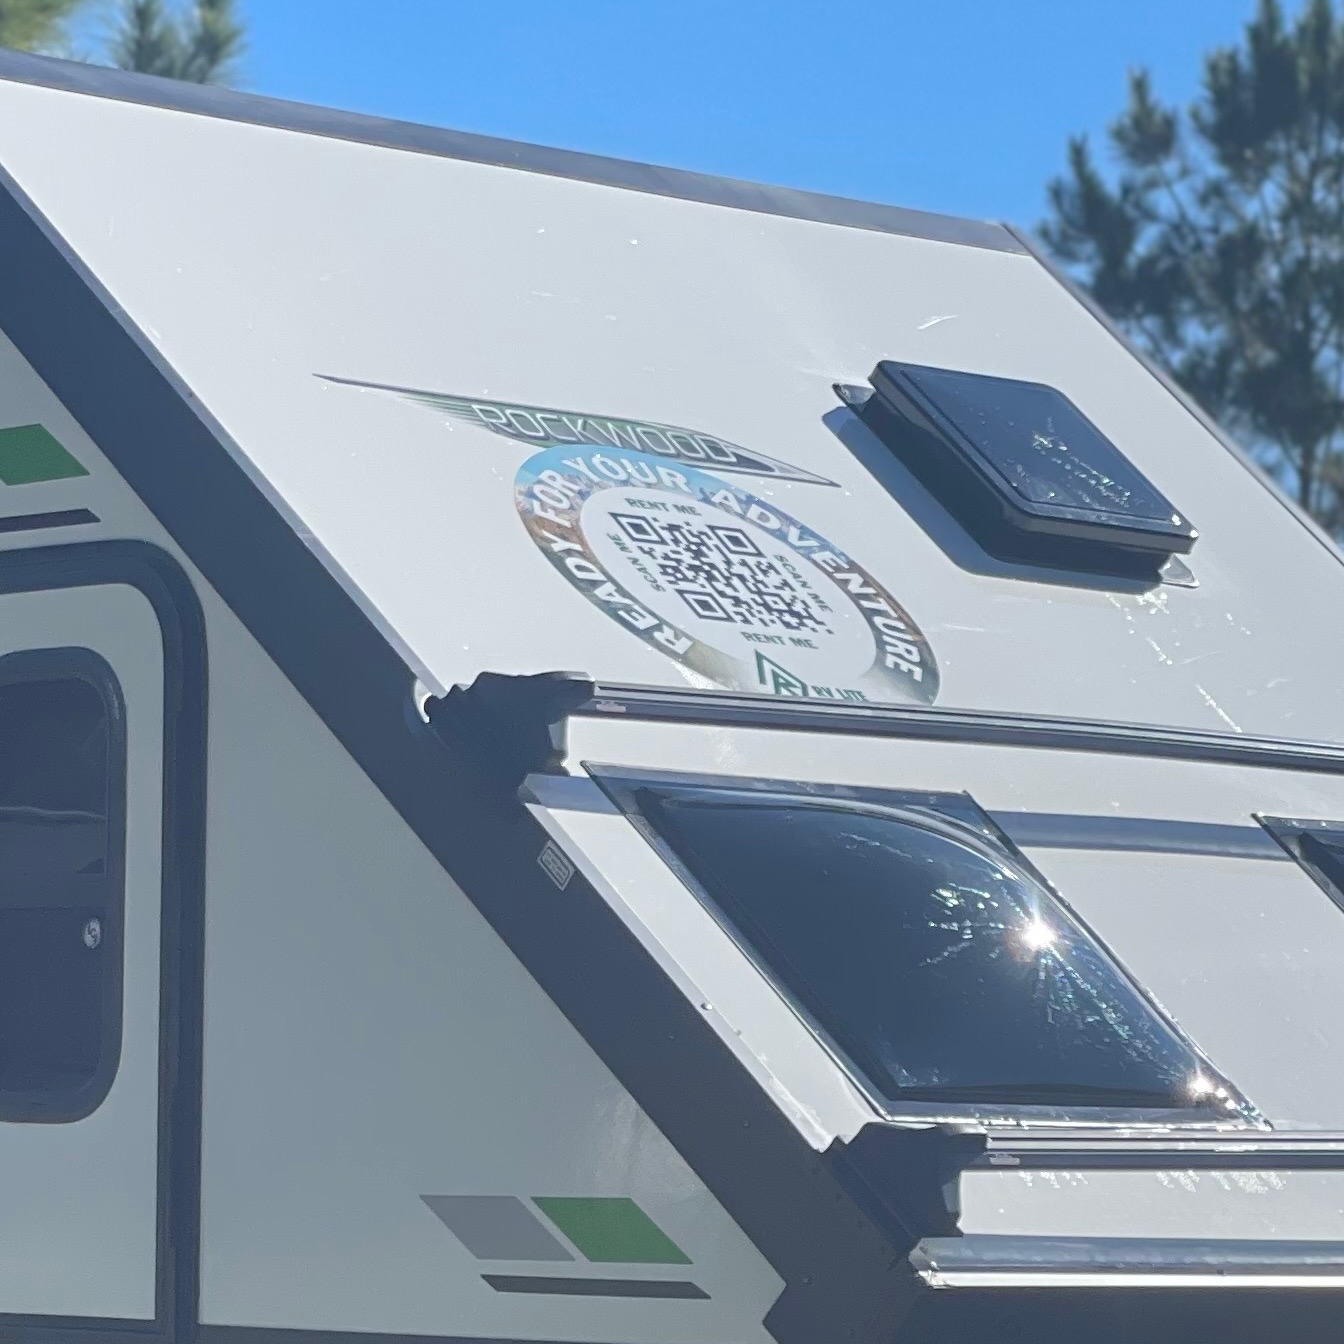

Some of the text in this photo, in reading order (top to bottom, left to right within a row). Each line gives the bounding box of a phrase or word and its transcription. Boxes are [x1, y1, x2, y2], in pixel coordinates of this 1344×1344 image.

[471, 404, 737, 462] ROCKWOOD
[624, 498, 702, 517] RENT ME
[533, 453, 924, 683] READY FOR YOUR ADVENTURE
[606, 532, 667, 593] SCAN ME
[773, 554, 834, 613] SCAN ME
[740, 631, 819, 650] RENT ME
[811, 685, 871, 702] RV LITE
